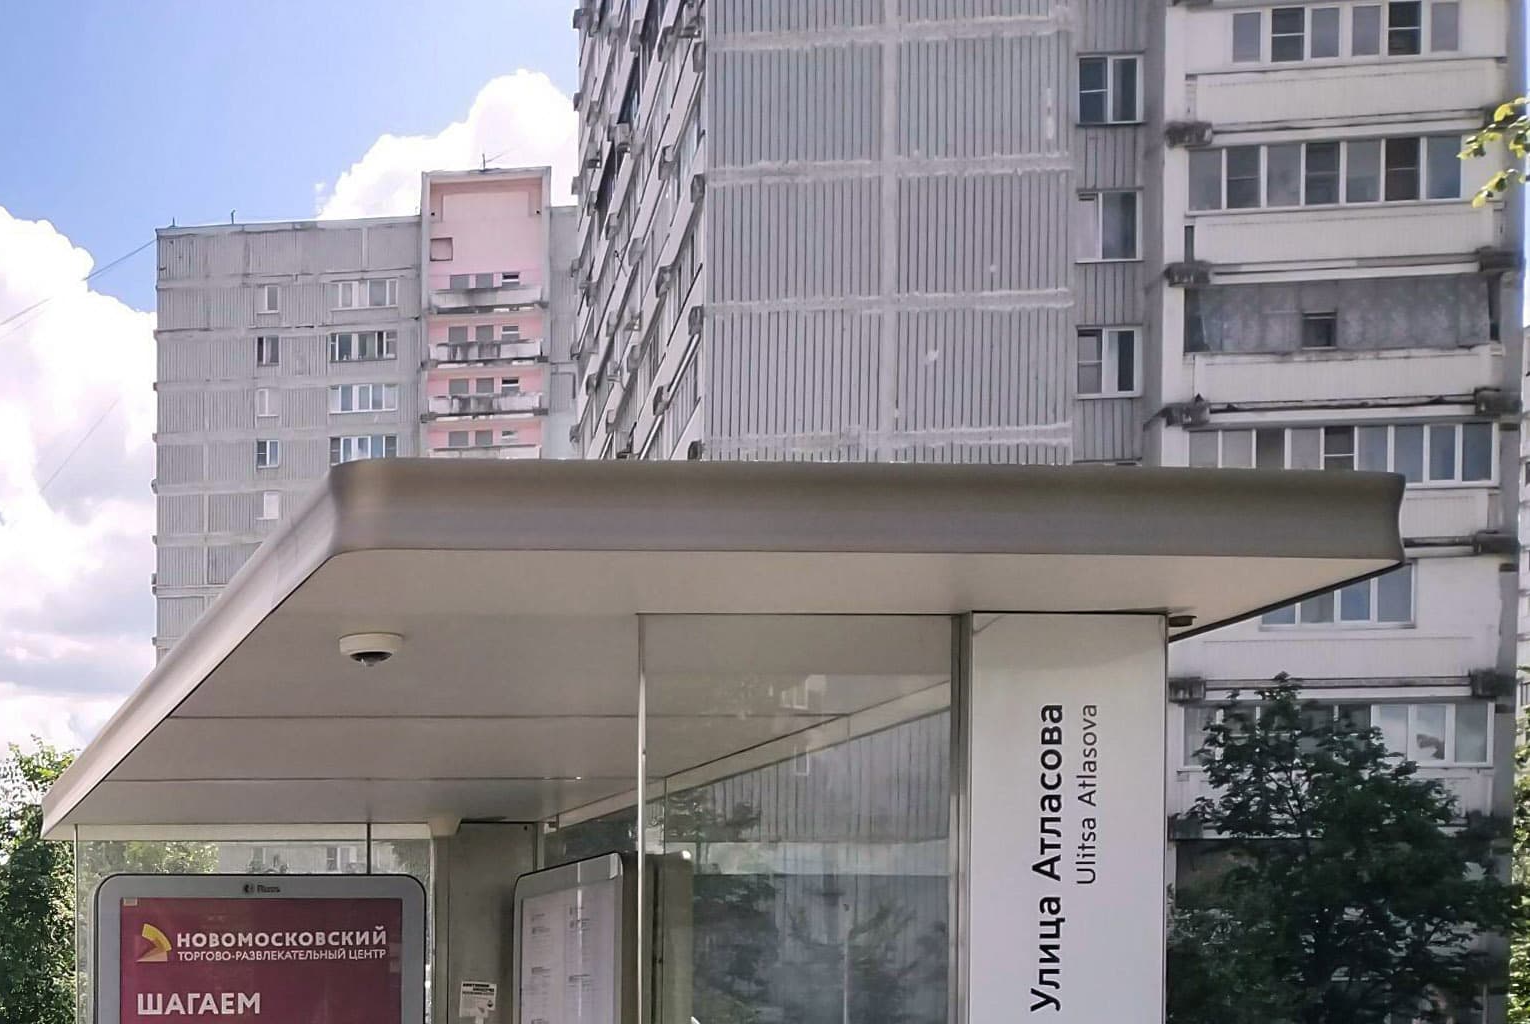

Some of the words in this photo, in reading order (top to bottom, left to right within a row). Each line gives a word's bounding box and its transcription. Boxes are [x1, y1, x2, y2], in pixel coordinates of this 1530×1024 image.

[1075, 703, 1098, 807] Atlasova
[1031, 703, 1063, 882] Атласова
[1075, 816, 1097, 884] Ulitsa
[177, 925, 387, 948] НОВОМОСКОВСКИЙ
[178, 948, 346, 961] ТОРГОВО-РАЗВЛЕКАТЕЛЬНЫЙ
[349, 949, 386, 961] ЦЕНТР
[1030, 896, 1066, 1012] Улица
[137, 992, 261, 1015] ШАГАЕМ
